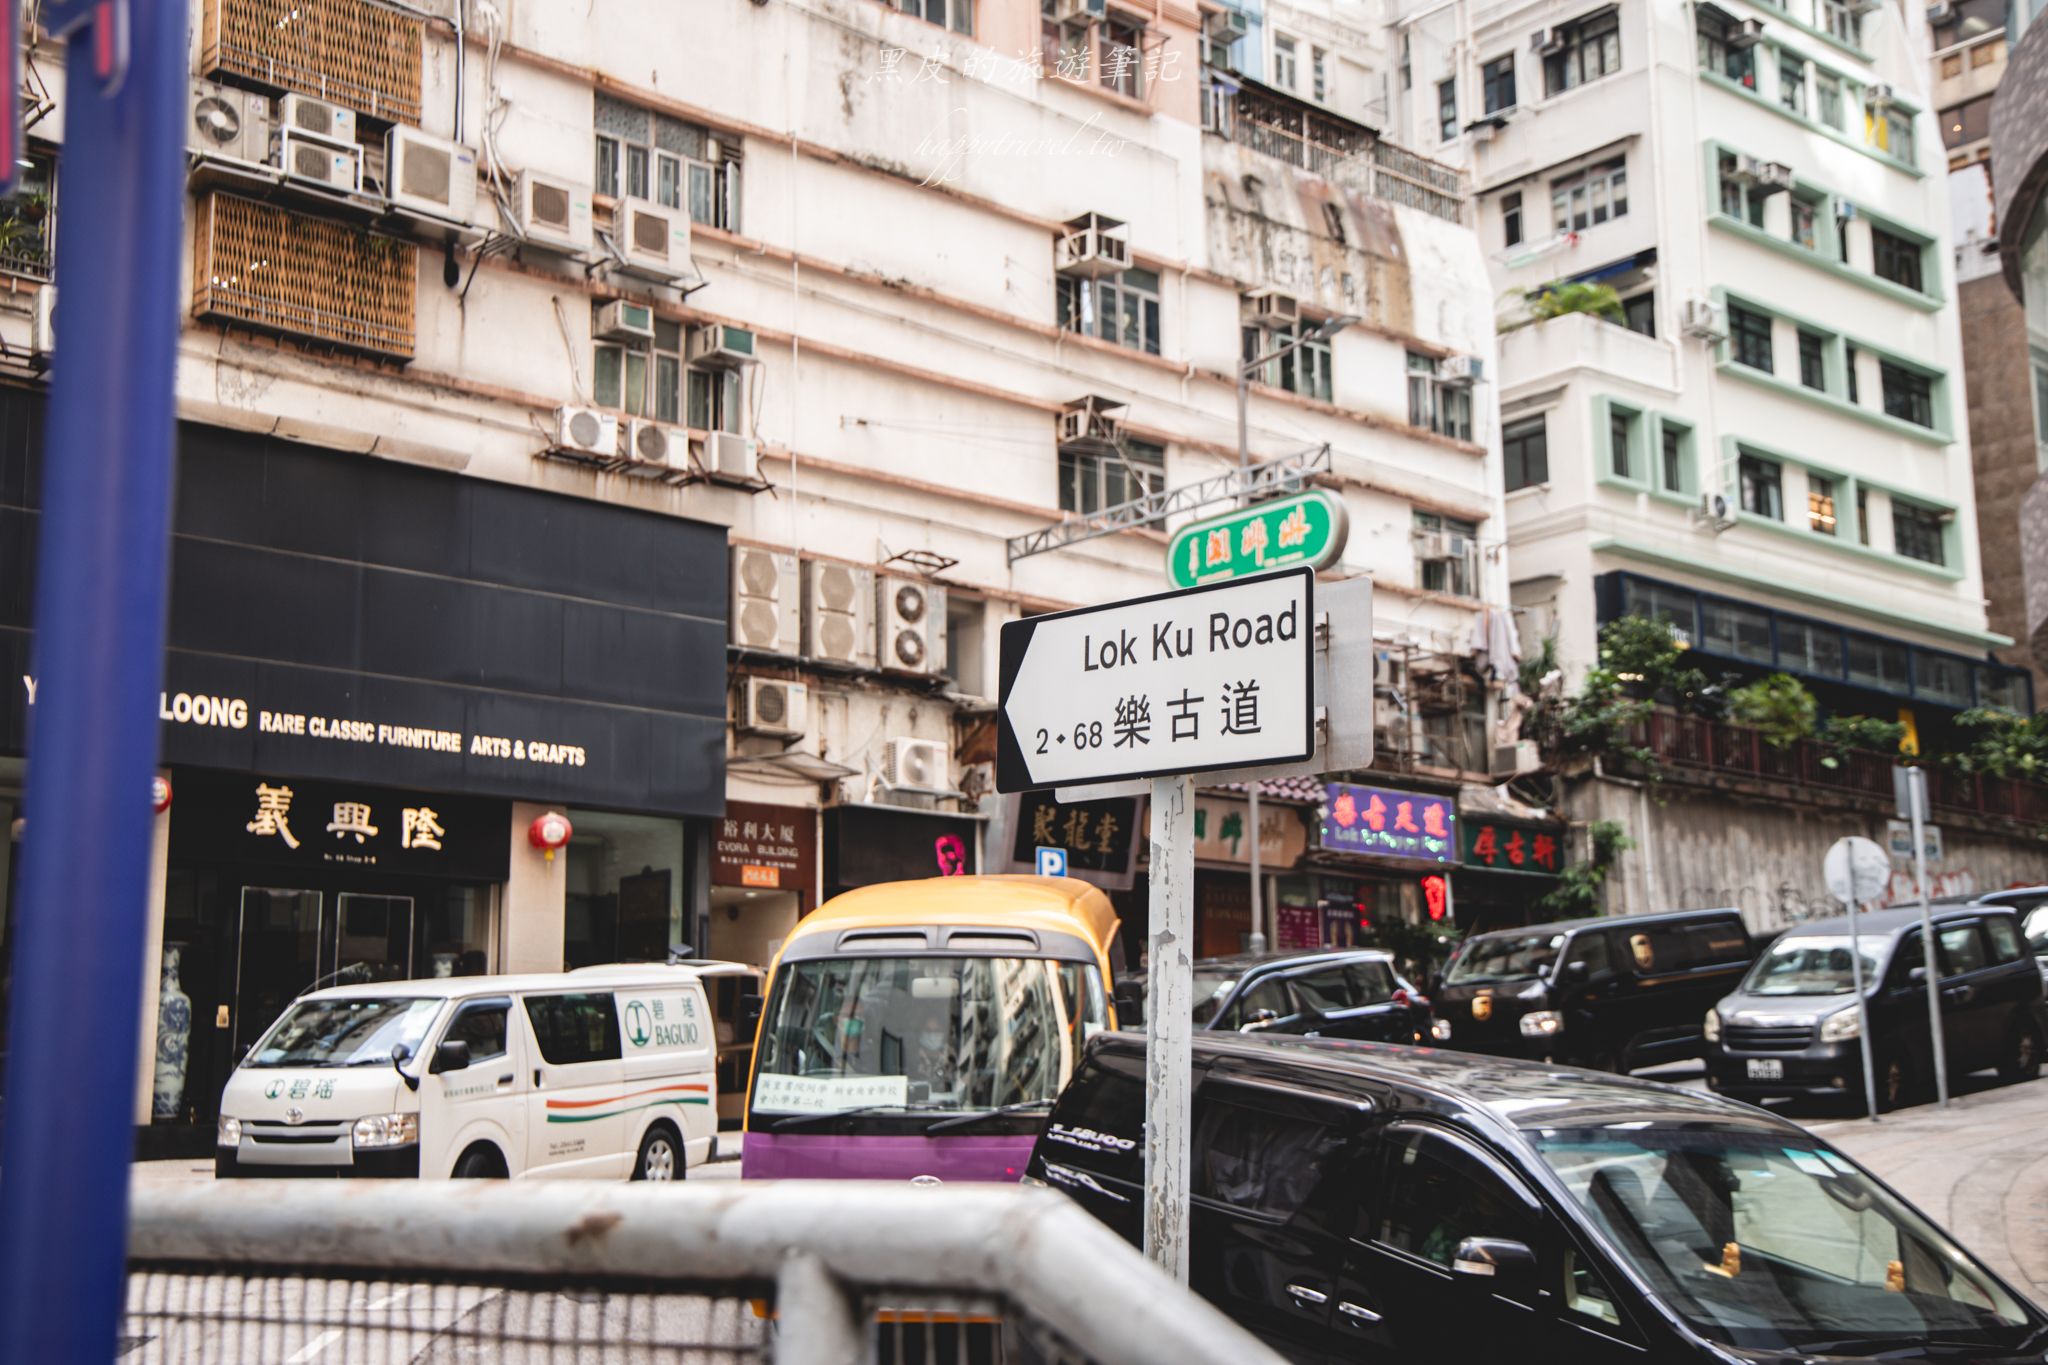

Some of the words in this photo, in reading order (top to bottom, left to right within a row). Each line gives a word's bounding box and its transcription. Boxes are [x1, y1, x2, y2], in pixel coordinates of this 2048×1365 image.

[1084, 629, 1138, 672] Lok
[1152, 620, 1194, 662] Ku
[1208, 599, 1298, 652] Road
[158, 691, 249, 730] LOONG
[259, 710, 306, 735] RARE
[309, 716, 375, 743] CLASSIC
[378, 724, 462, 753] FURNITURE
[470, 735, 511, 759] ARTS
[513, 740, 526, 760] &
[528, 741, 587, 767] CRAFTS
[1113, 678, 1262, 749] 樂古道
[246, 782, 445, 851] 義興隆
[717, 840, 751, 854] EVORA
[757, 844, 799, 859] BUILDING
[1041, 850, 1063, 877] P
[655, 1023, 698, 1046] BAGUIO
